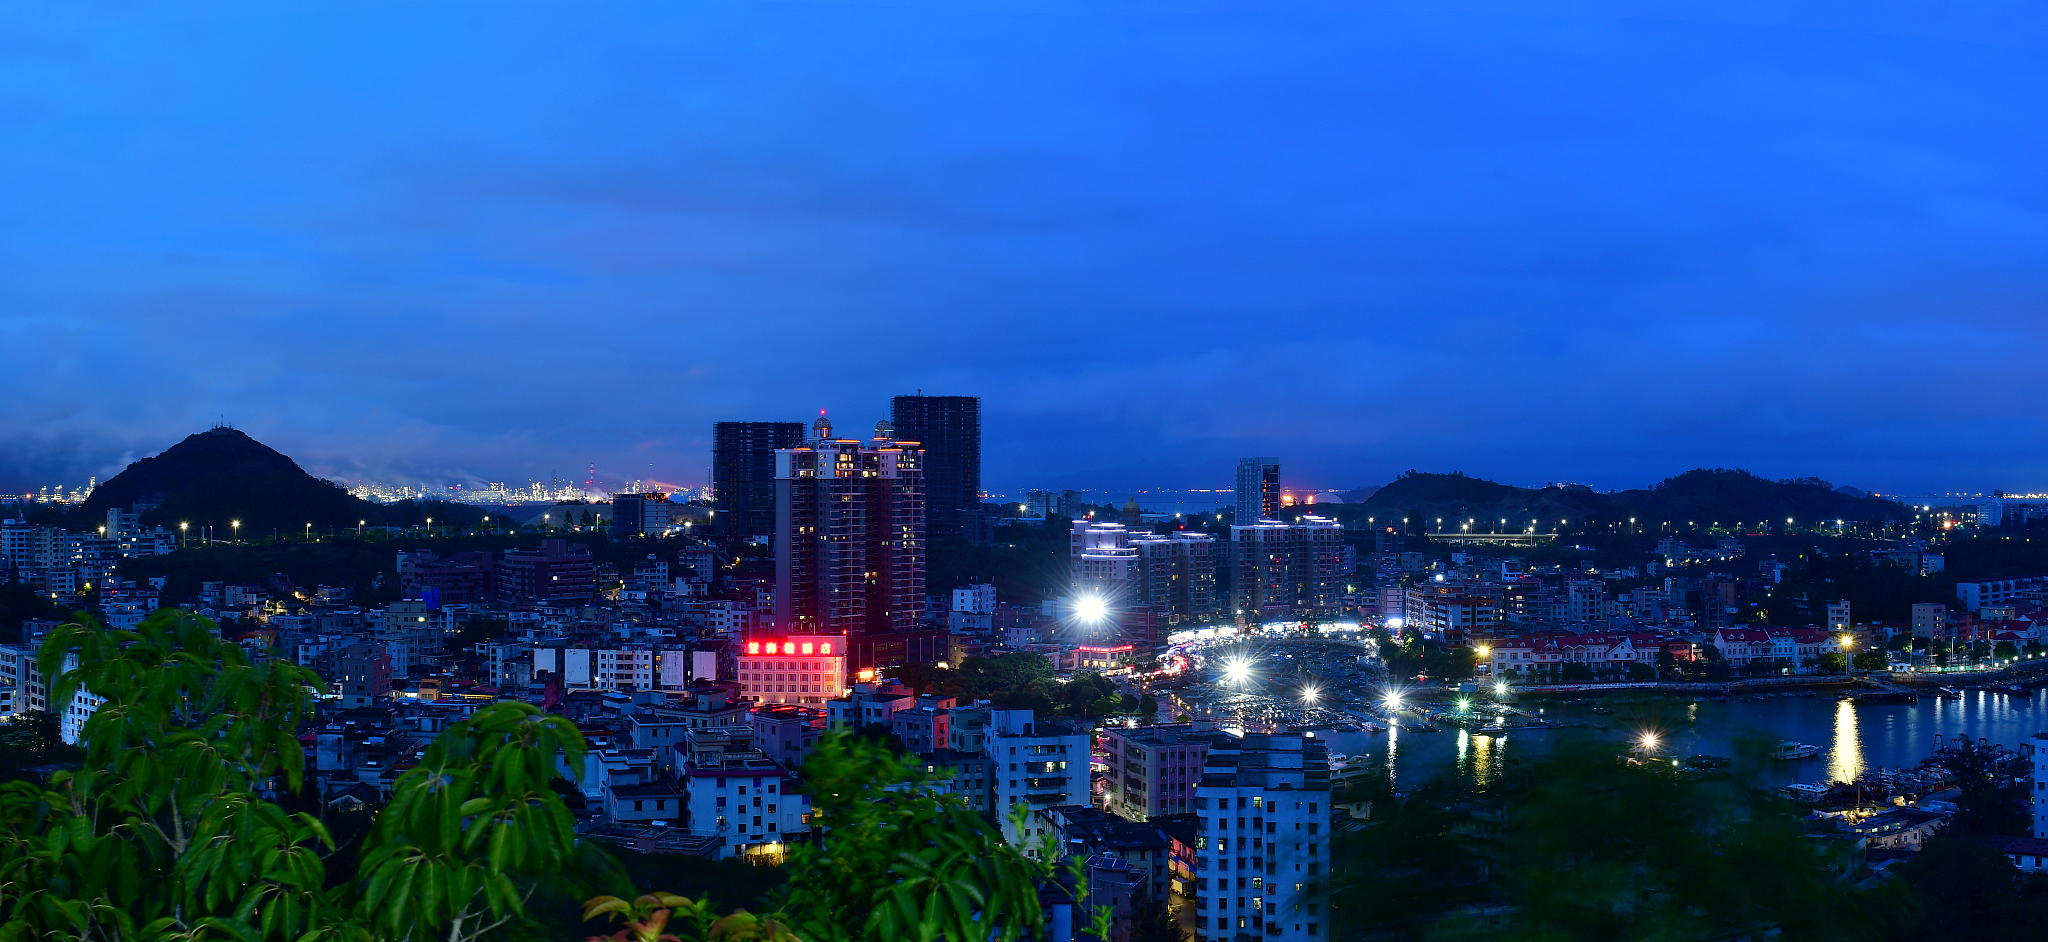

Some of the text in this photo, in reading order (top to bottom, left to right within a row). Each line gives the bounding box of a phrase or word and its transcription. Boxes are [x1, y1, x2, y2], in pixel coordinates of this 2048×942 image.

[748, 642, 831, 655] 望海楼酒店
